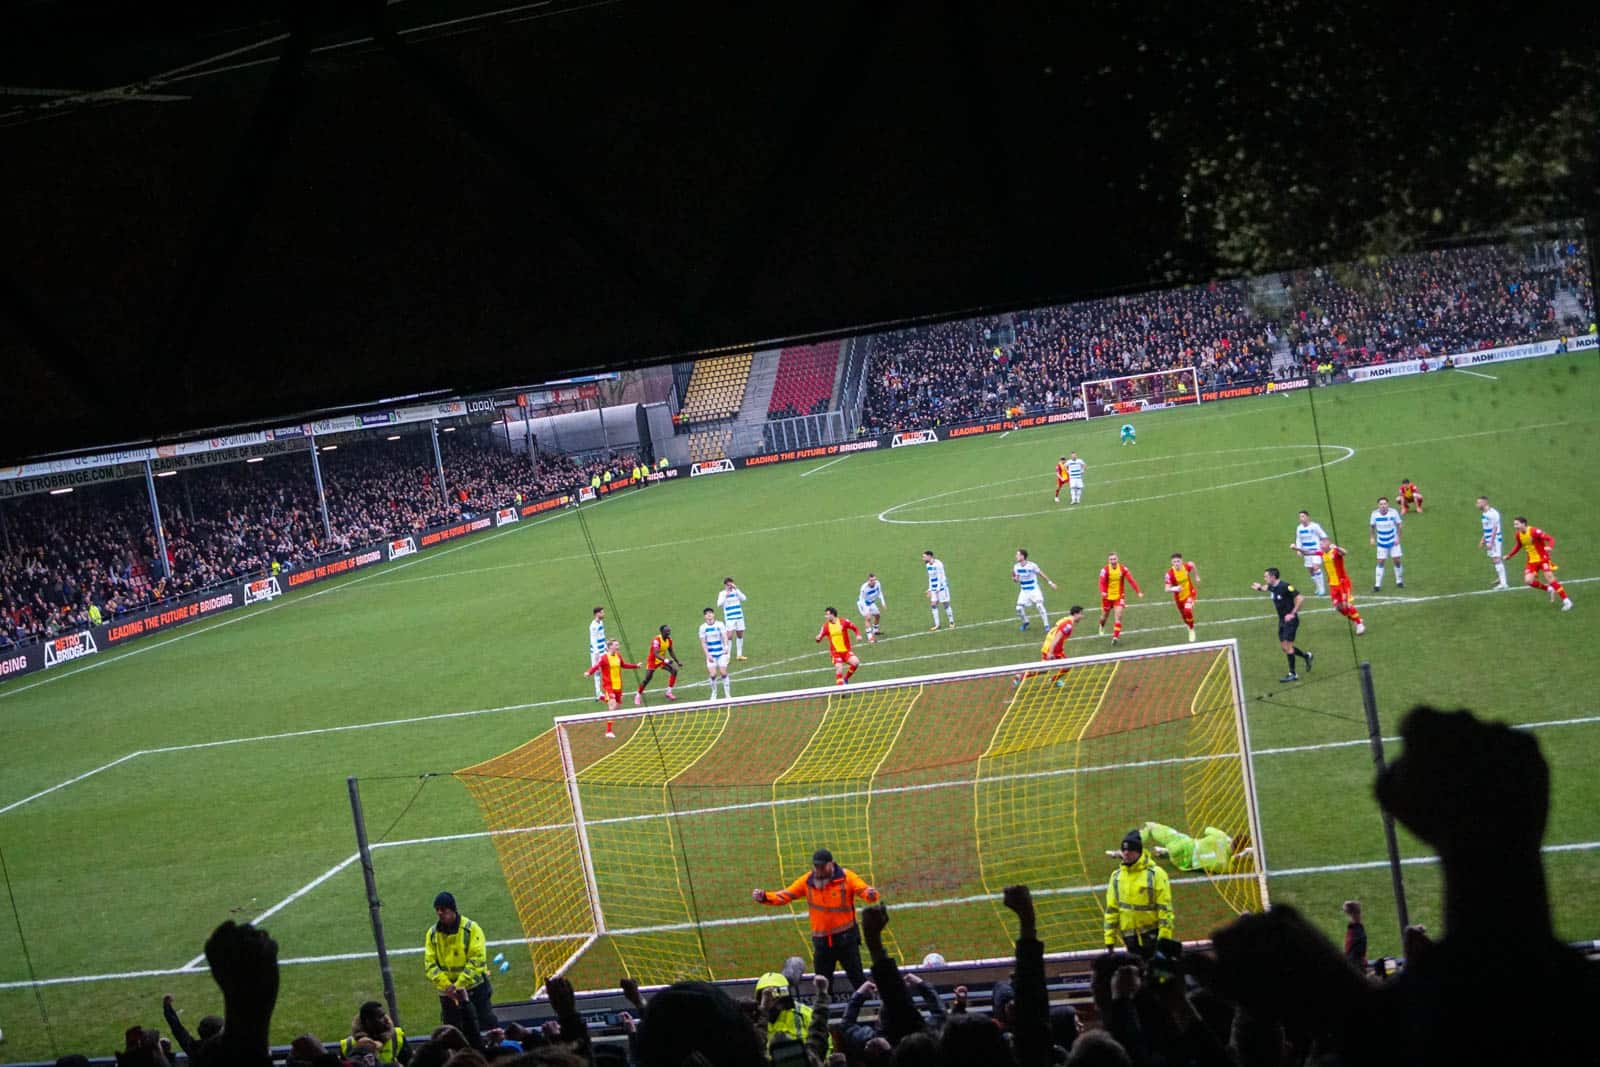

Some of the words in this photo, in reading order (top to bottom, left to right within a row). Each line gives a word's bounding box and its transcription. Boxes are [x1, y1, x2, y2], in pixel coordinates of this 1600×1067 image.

[746, 454, 779, 465] LEADING
[780, 451, 796, 460] THE
[797, 447, 826, 459] FUTURE
[828, 445, 839, 454] OF
[840, 440, 878, 453] BRIDGING
[15, 468, 114, 493] RETROBRIDGE.COM
[108, 621, 143, 641] LEADING
[144, 615, 160, 630] THE
[160, 606, 189, 625] FUTURE
[189, 603, 199, 615] OF
[200, 594, 233, 613] BRIDGING
[54, 634, 80, 651] RETRO
[56, 644, 85, 662] BRIDGE
